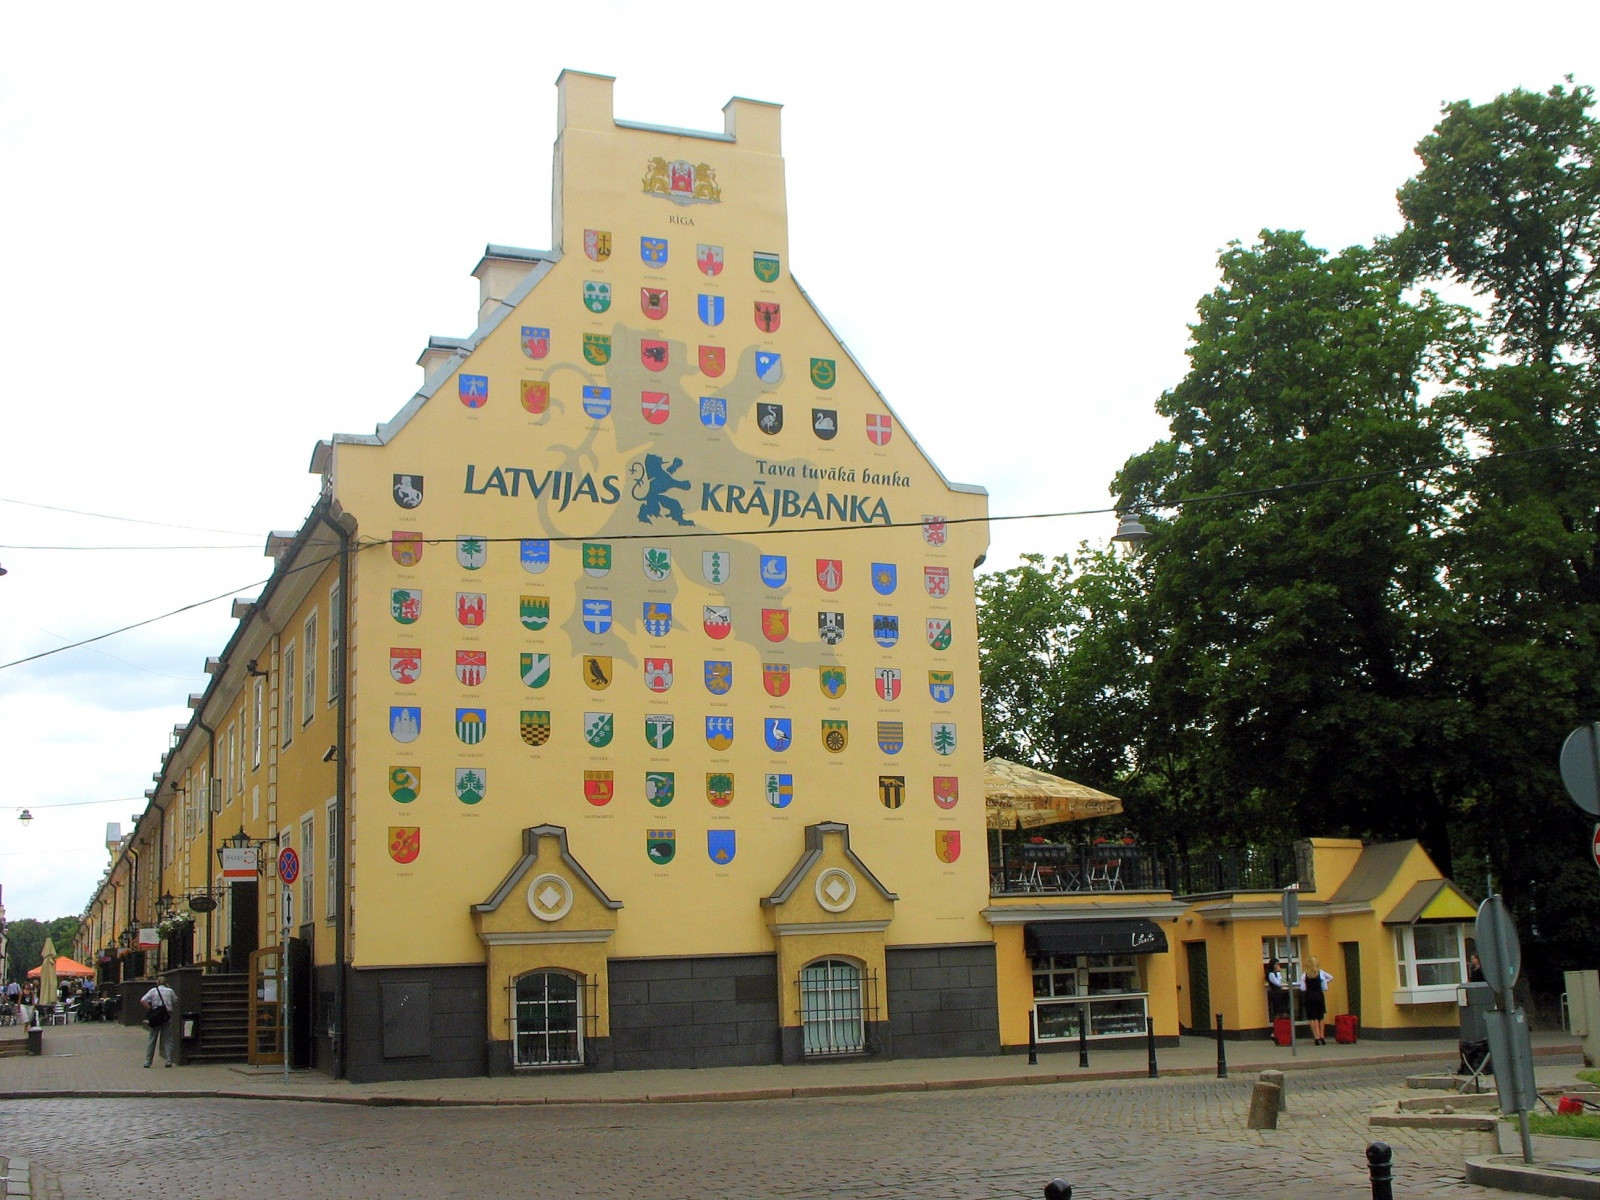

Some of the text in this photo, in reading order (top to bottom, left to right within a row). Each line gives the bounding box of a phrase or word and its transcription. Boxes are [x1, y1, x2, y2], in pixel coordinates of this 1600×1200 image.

[464, 464, 892, 527] LATVIJAS KRĀJBANKA
[756, 460, 910, 487] Tava tuvākā banka
